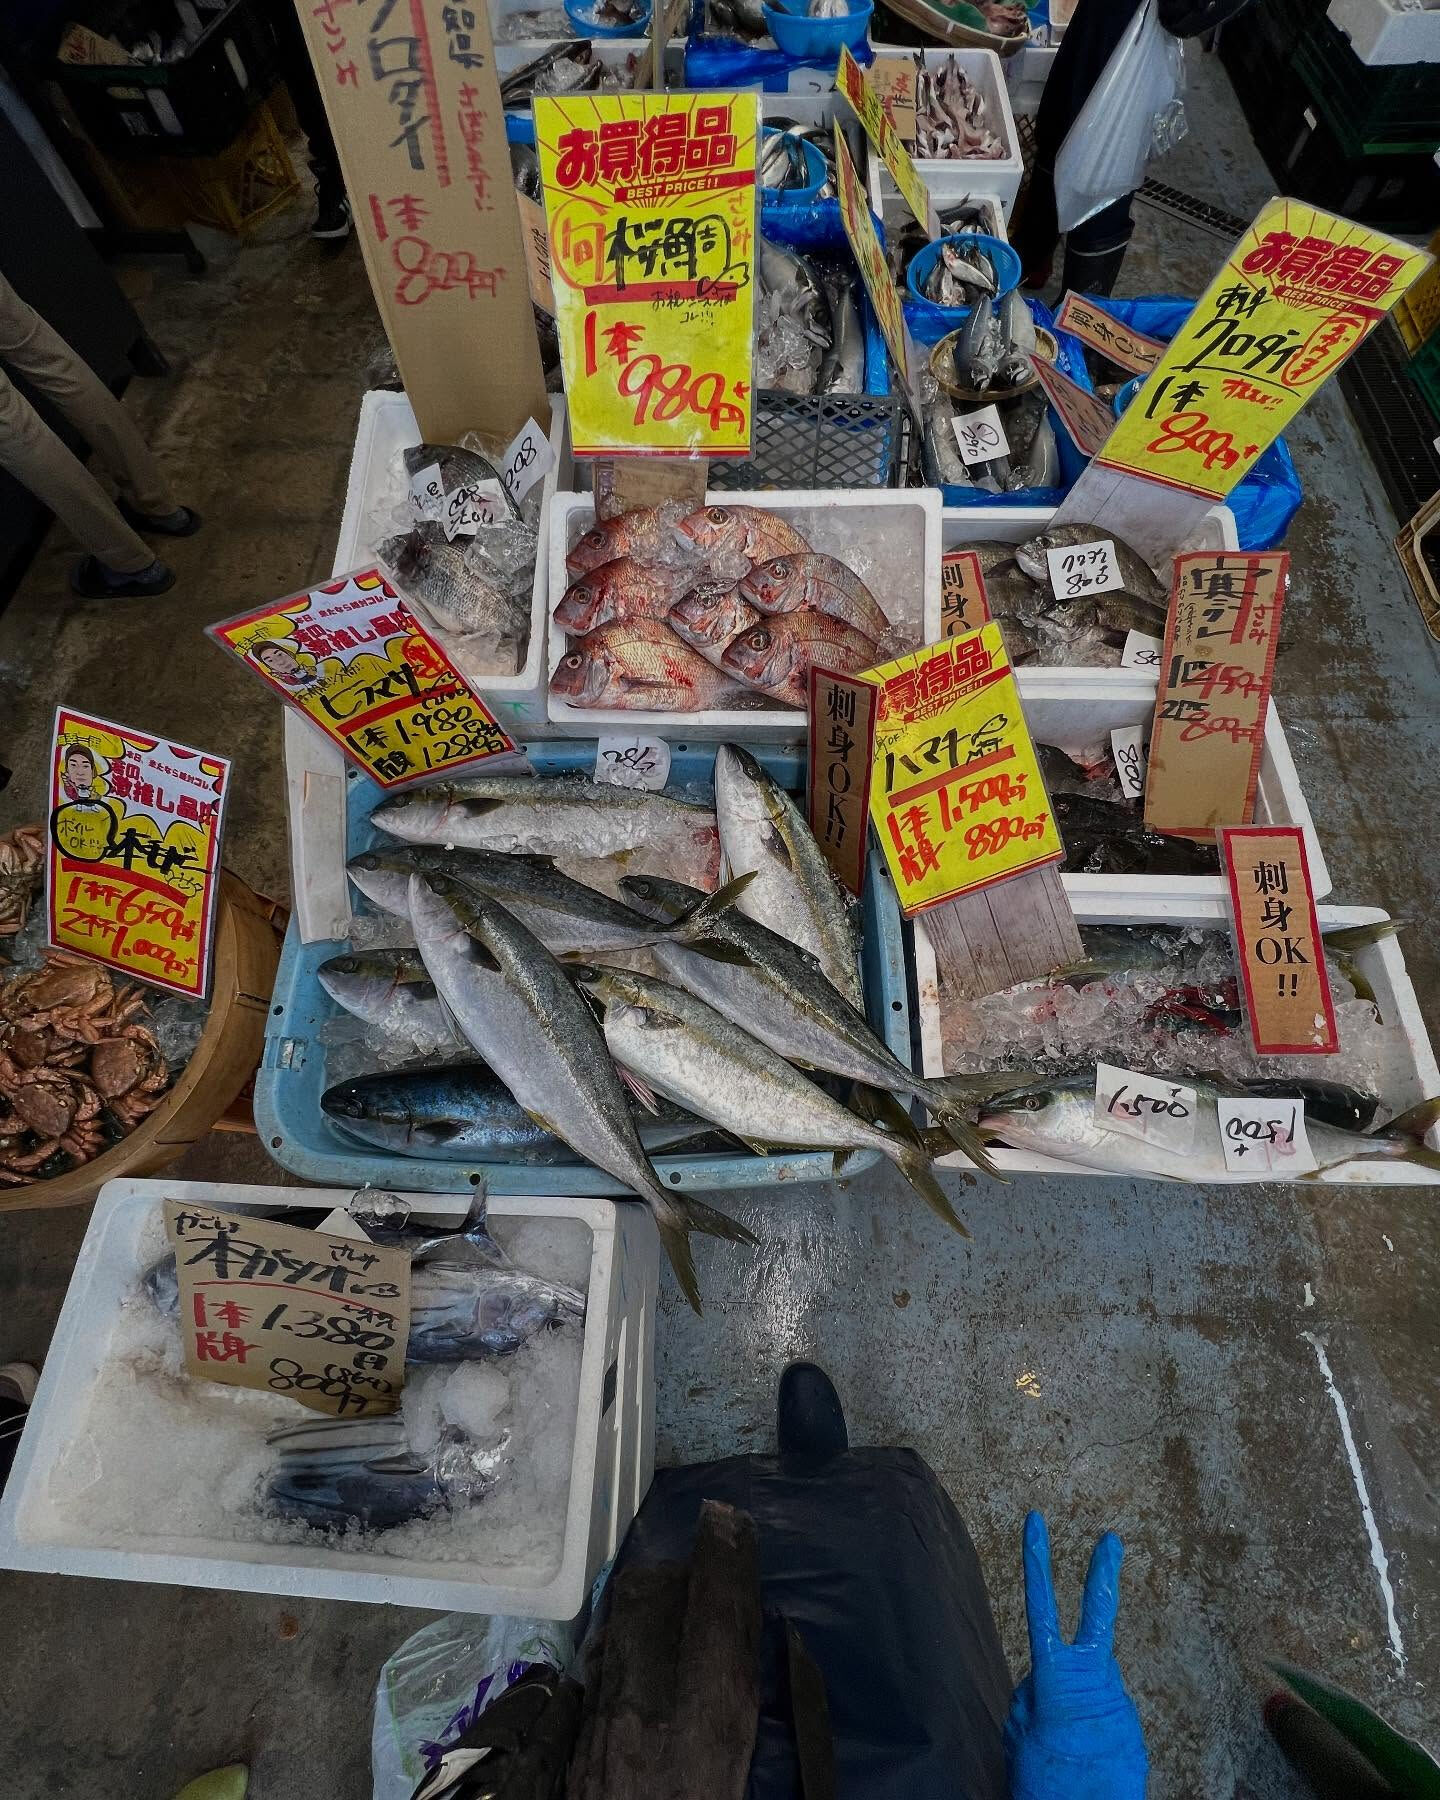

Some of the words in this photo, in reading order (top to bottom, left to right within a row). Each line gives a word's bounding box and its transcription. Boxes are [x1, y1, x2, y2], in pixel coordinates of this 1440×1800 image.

[440, 0, 484, 69] 知県
[555, 104, 738, 190] お買得品
[368, 193, 431, 242] 1本
[626, 184, 662, 200] BEST
[664, 176, 719, 195] PRICE!!
[604, 213, 731, 291] 桜鯛
[1241, 230, 1406, 302] お買得品
[1282, 287, 1314, 304] BEST
[584, 310, 647, 378] 1本
[1192, 318, 1304, 374] クロダイ
[1144, 375, 1210, 420] 1本
[912, 702, 941, 719] BEST
[942, 679, 984, 707] PRICE!!
[826, 684, 857, 849] 刺身OK!!
[885, 727, 972, 793] ハマチ
[1252, 860, 1311, 998] 刺身OK!!
[194, 1292, 255, 1329] 1本
